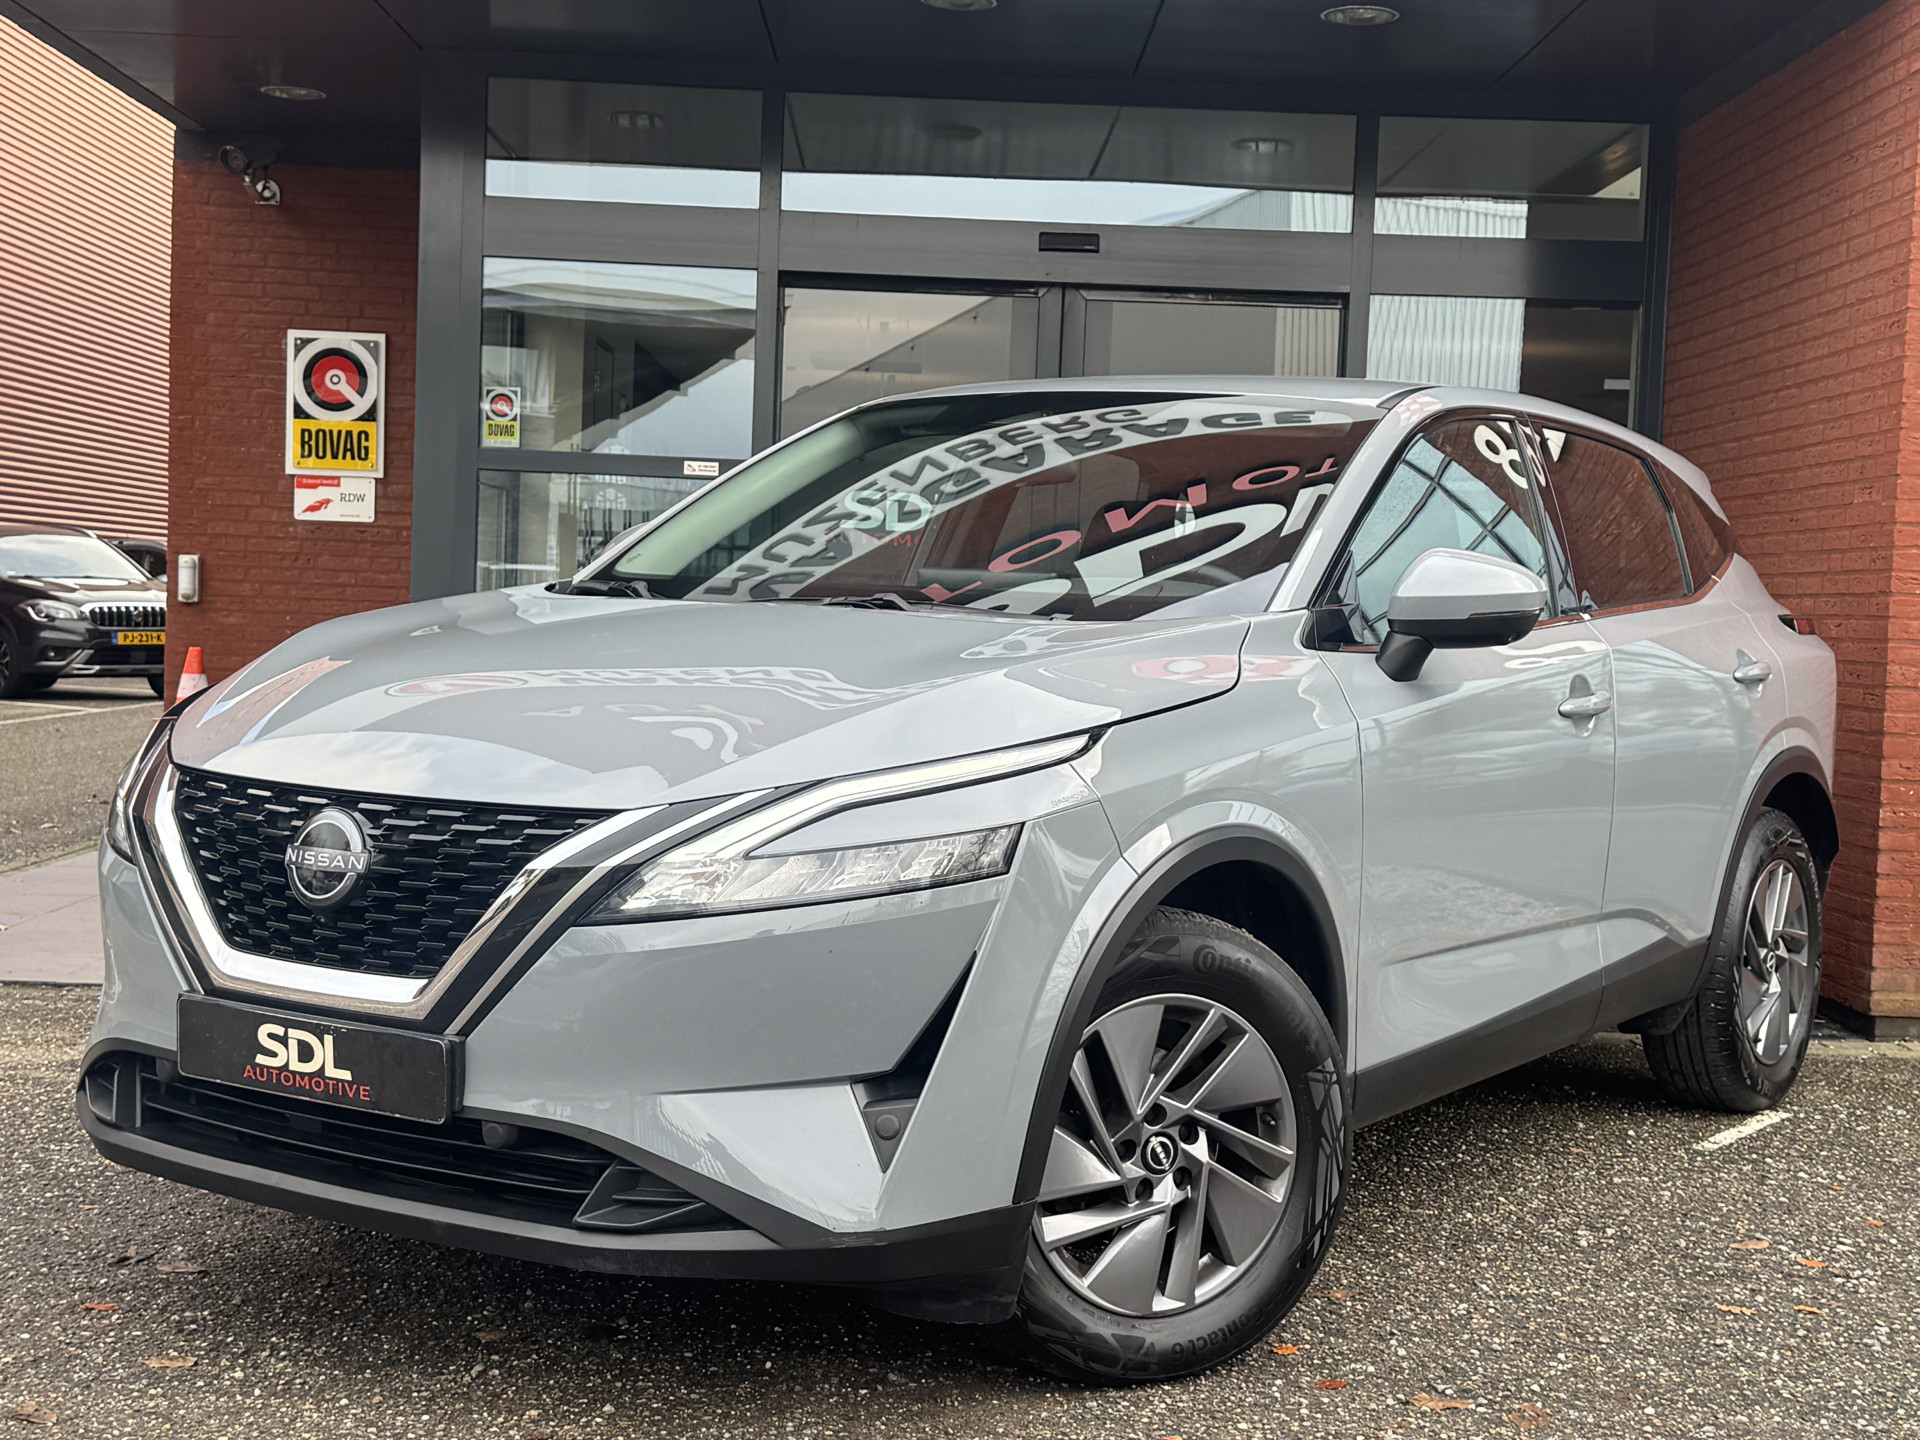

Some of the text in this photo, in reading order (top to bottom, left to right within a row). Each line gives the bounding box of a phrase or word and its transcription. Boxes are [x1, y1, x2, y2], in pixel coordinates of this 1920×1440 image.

[488, 423, 515, 437] BOVAG
[300, 428, 370, 461] BOVAG
[340, 493, 366, 502] RDW
[123, 633, 163, 643] PJ-231-K
[287, 847, 365, 870] NISSAN
[255, 1023, 352, 1081] SDL
[243, 1064, 371, 1101] AUTOMOTIVE
